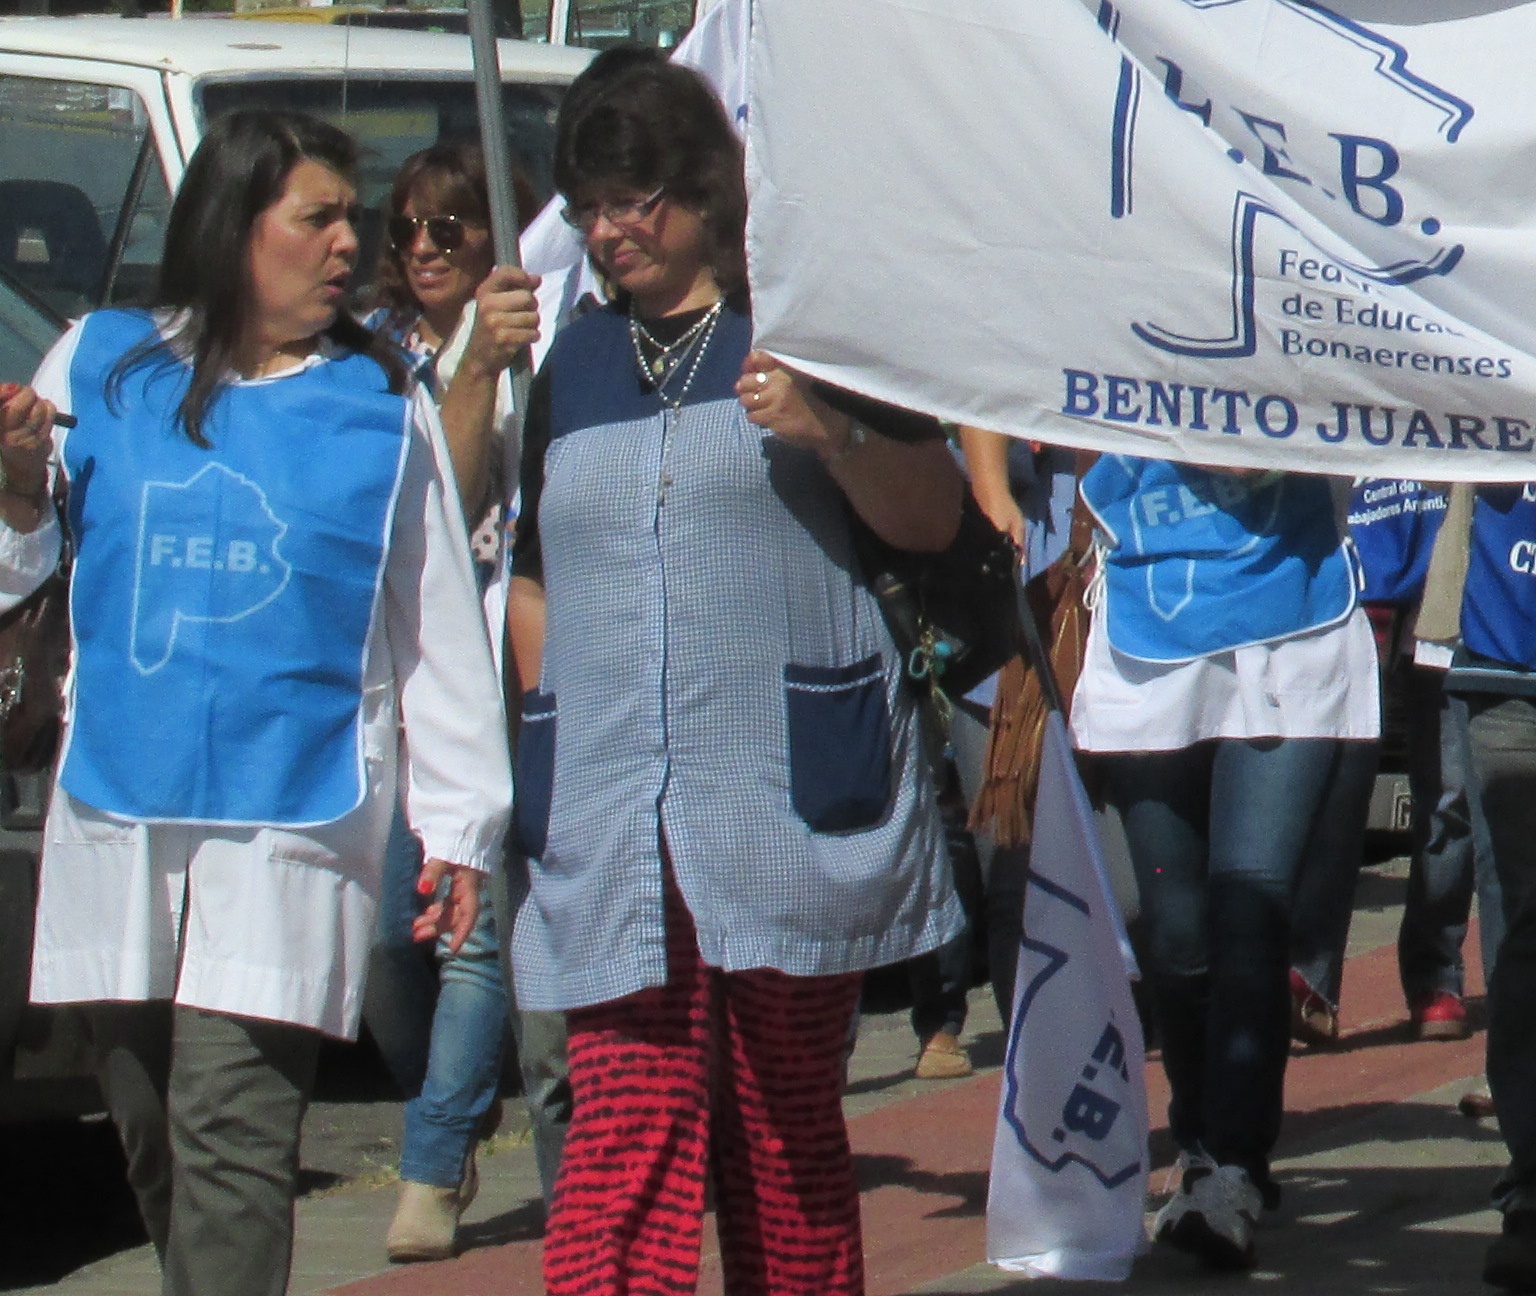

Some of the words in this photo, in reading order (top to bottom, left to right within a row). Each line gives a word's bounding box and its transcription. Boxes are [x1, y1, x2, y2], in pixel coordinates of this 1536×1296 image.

[1281, 293, 1324, 320] de
[1335, 297, 1465, 338] Educa
[1279, 327, 1513, 380] Bonaerenses
[1062, 368, 1299, 439] BENITO
[150, 533, 271, 574] F.E.B.
